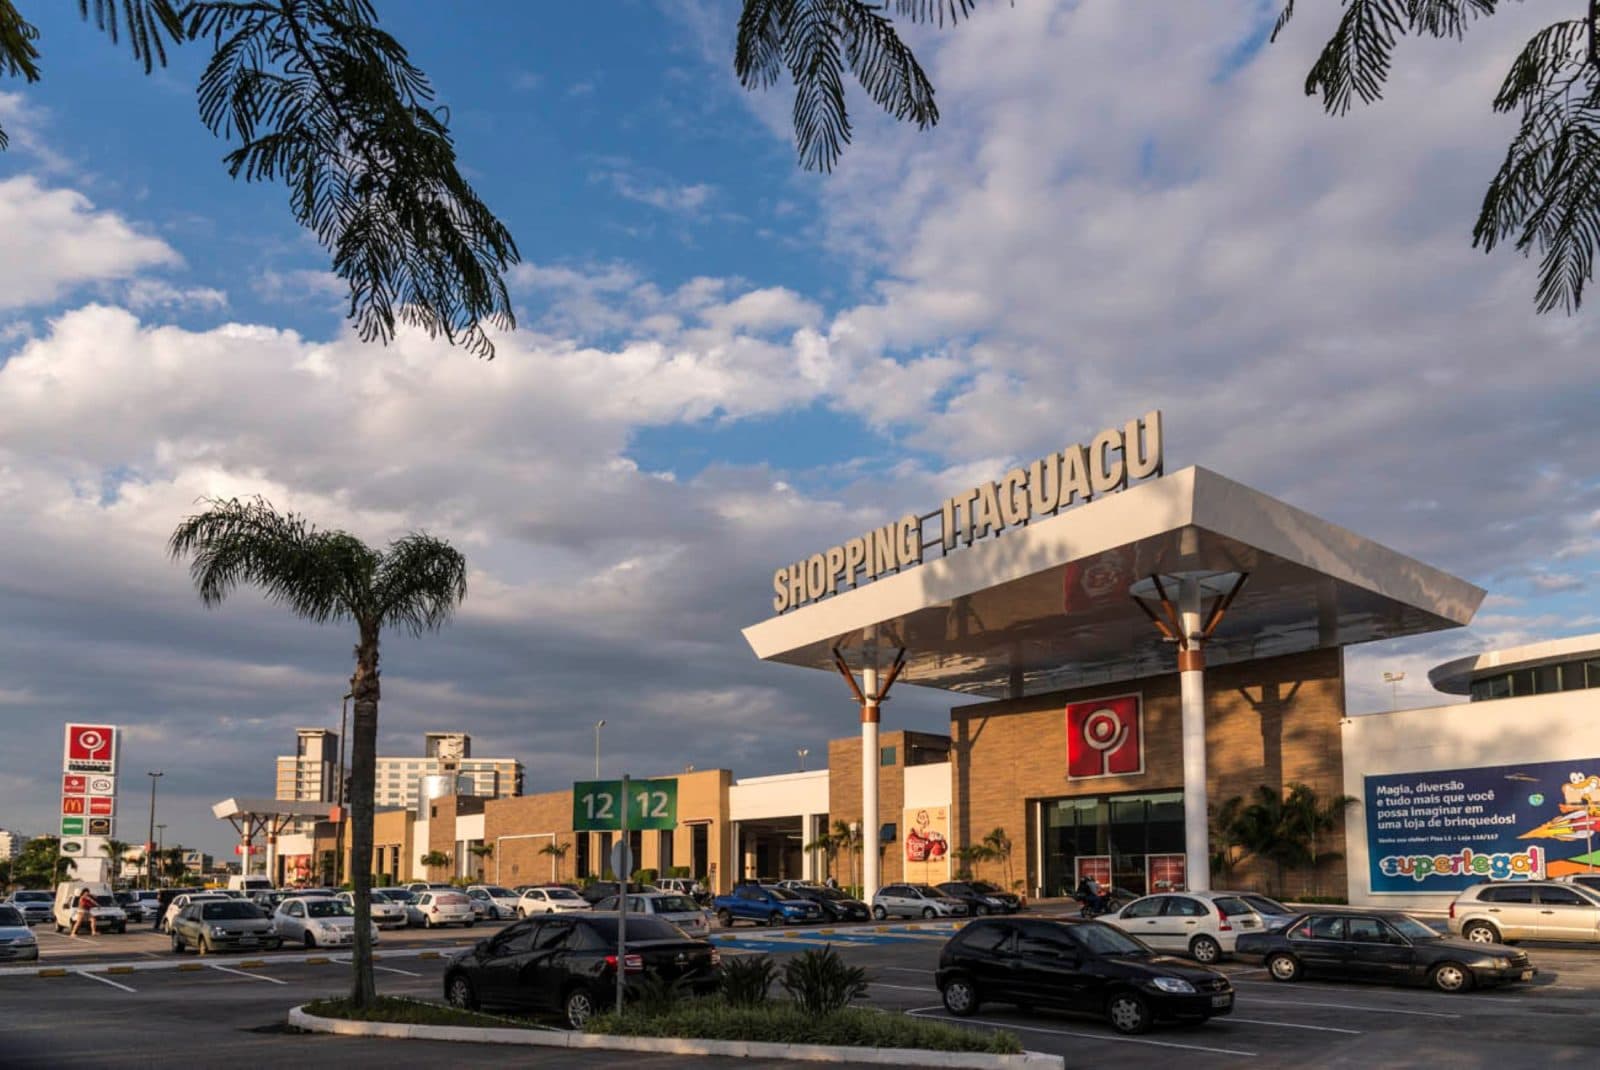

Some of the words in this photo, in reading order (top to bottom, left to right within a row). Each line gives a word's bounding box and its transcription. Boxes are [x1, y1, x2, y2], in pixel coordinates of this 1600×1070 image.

[773, 514, 922, 612] SHOPPING
[1376, 784, 1413, 796] Magia,
[1415, 780, 1464, 793] diversão
[1376, 799, 1384, 807] e
[1385, 796, 1411, 806] tudo
[1413, 793, 1440, 804] mais
[1442, 793, 1465, 805] que
[1467, 789, 1495, 801] você
[581, 792, 614, 819] 12
[636, 790, 669, 818] 12
[1377, 809, 1408, 820] possa
[1410, 805, 1461, 817] imaginar
[1464, 804, 1484, 814] em
[1377, 820, 1402, 829] uma
[1403, 817, 1425, 830] loja
[1427, 817, 1442, 828] de
[1443, 813, 1516, 828] brinquedos!
[1382, 847, 1540, 881] superlegal
